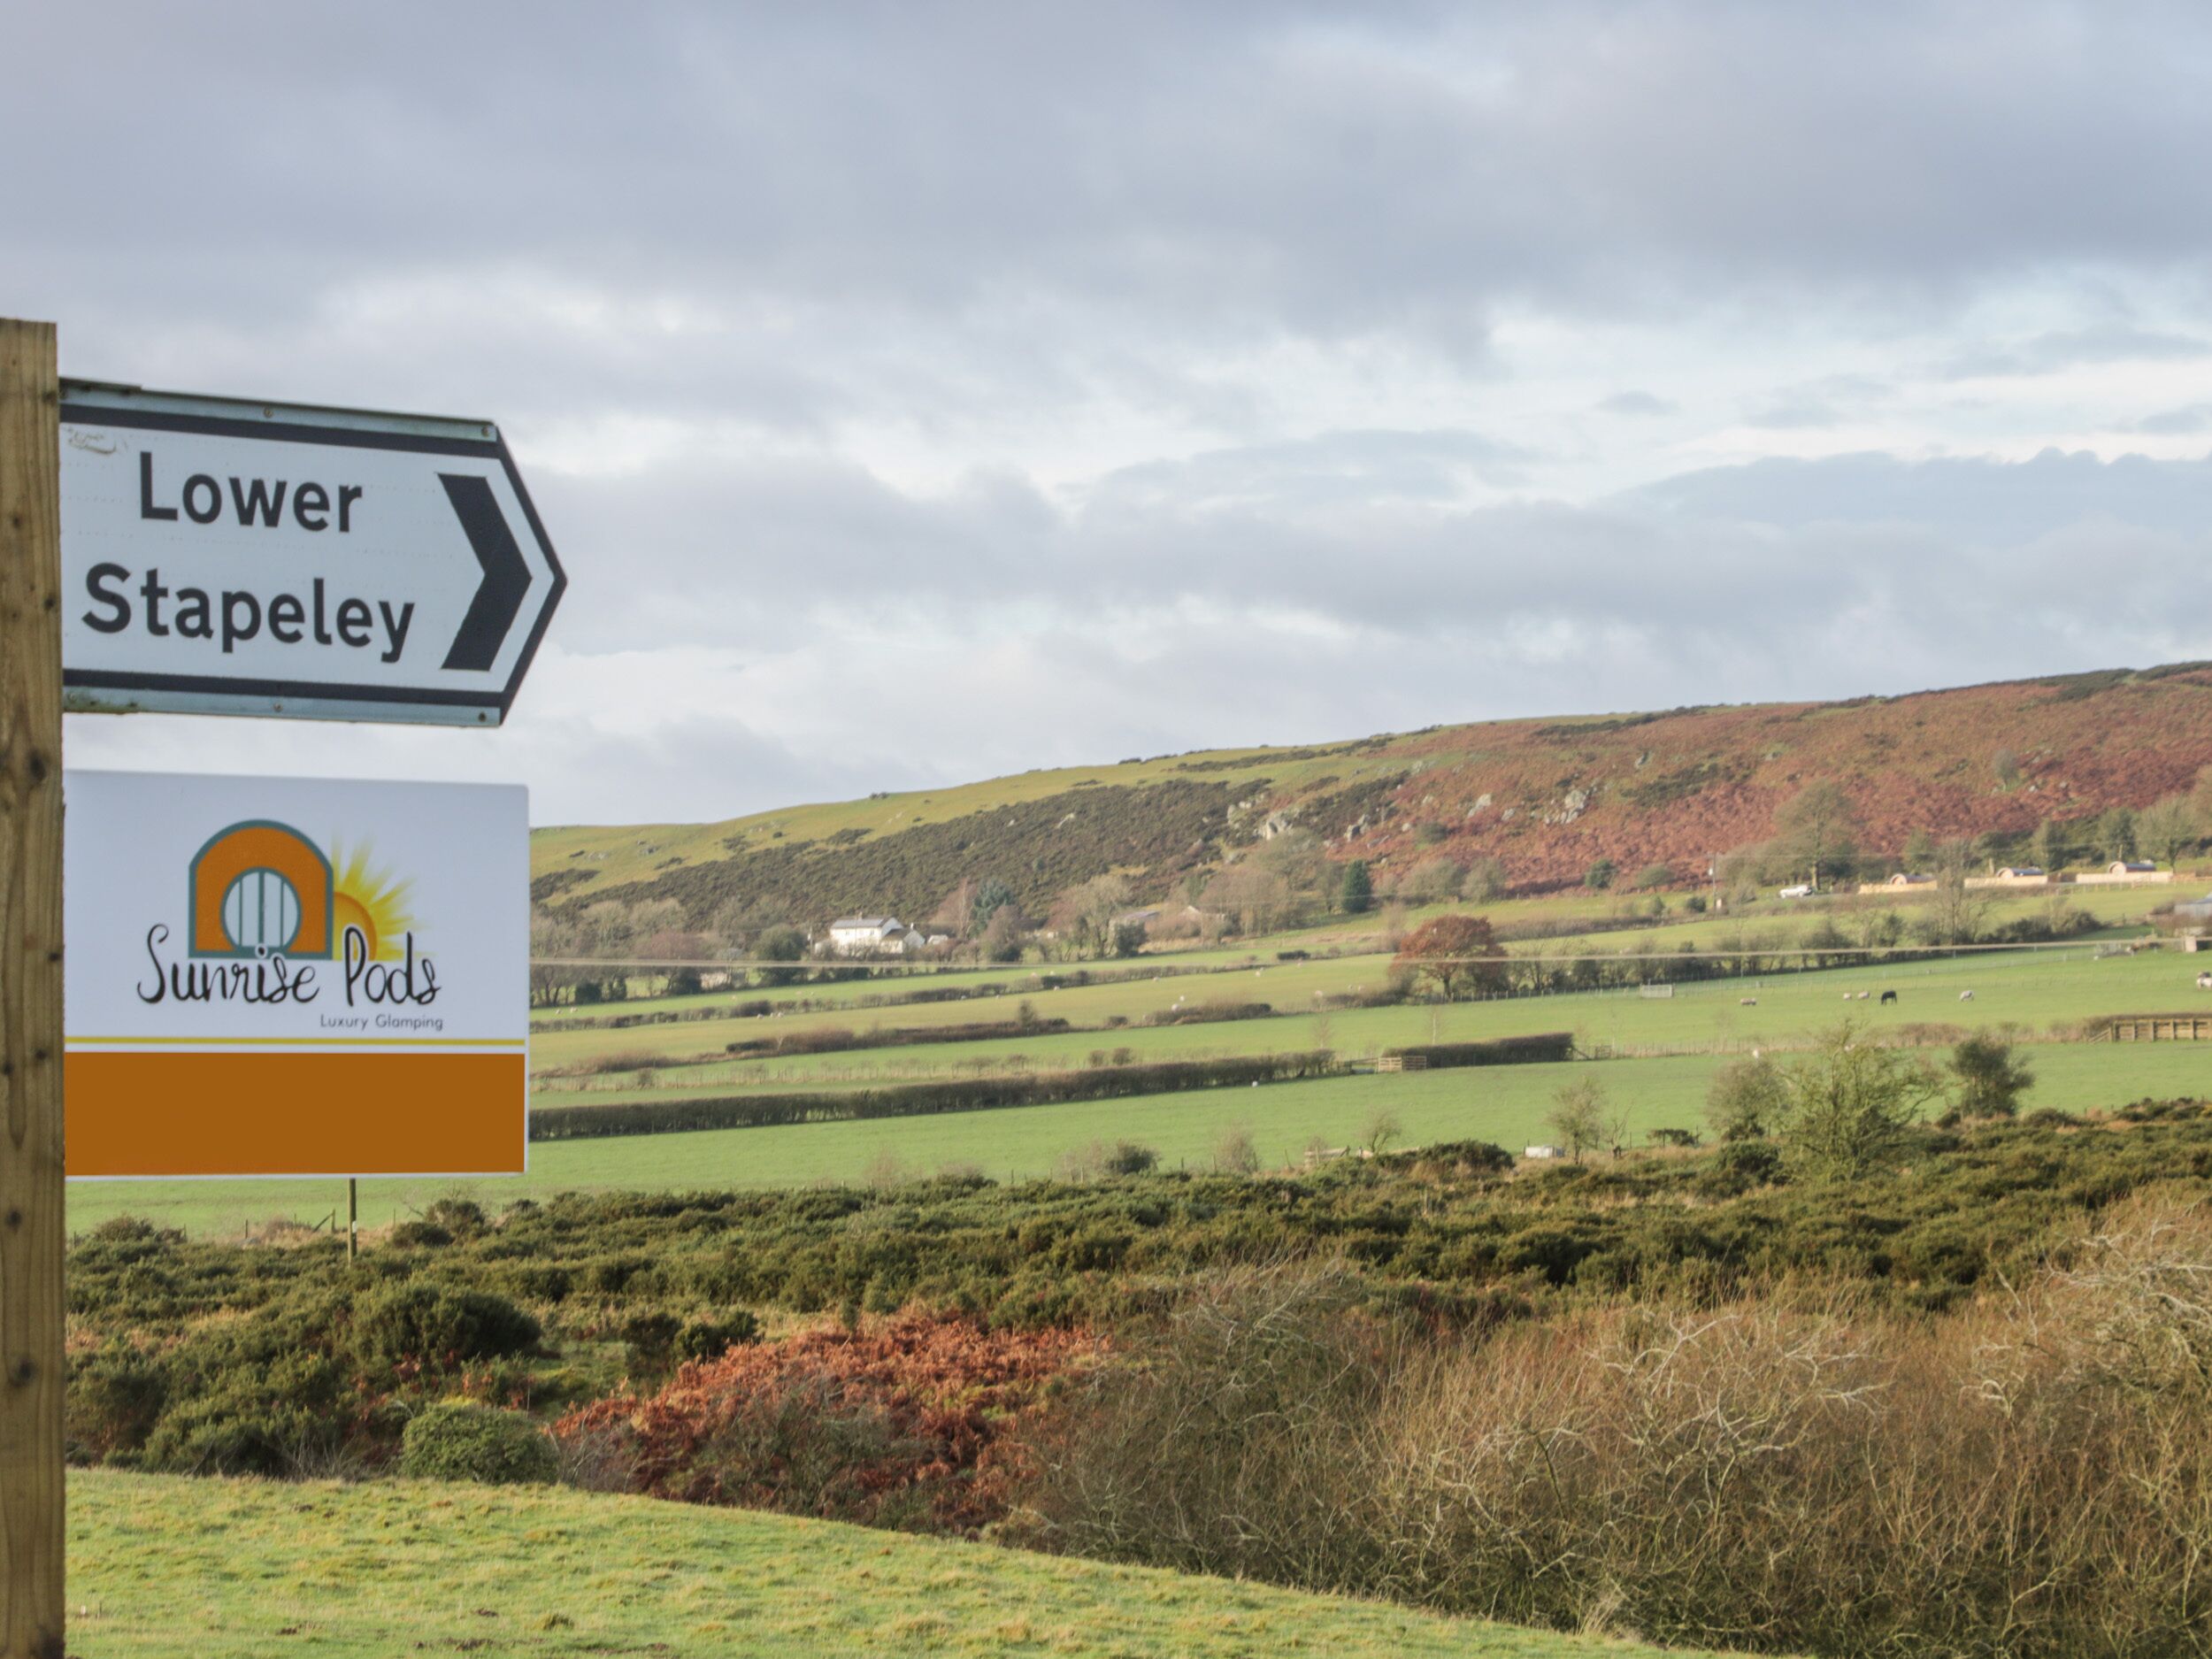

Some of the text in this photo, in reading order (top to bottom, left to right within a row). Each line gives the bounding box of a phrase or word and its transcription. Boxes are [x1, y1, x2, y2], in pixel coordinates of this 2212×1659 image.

[139, 450, 364, 533] Lower
[81, 561, 416, 664] Stapeley
[137, 923, 442, 1006] Sunrise Pods
[319, 1013, 444, 1032] Luxury Glamping
